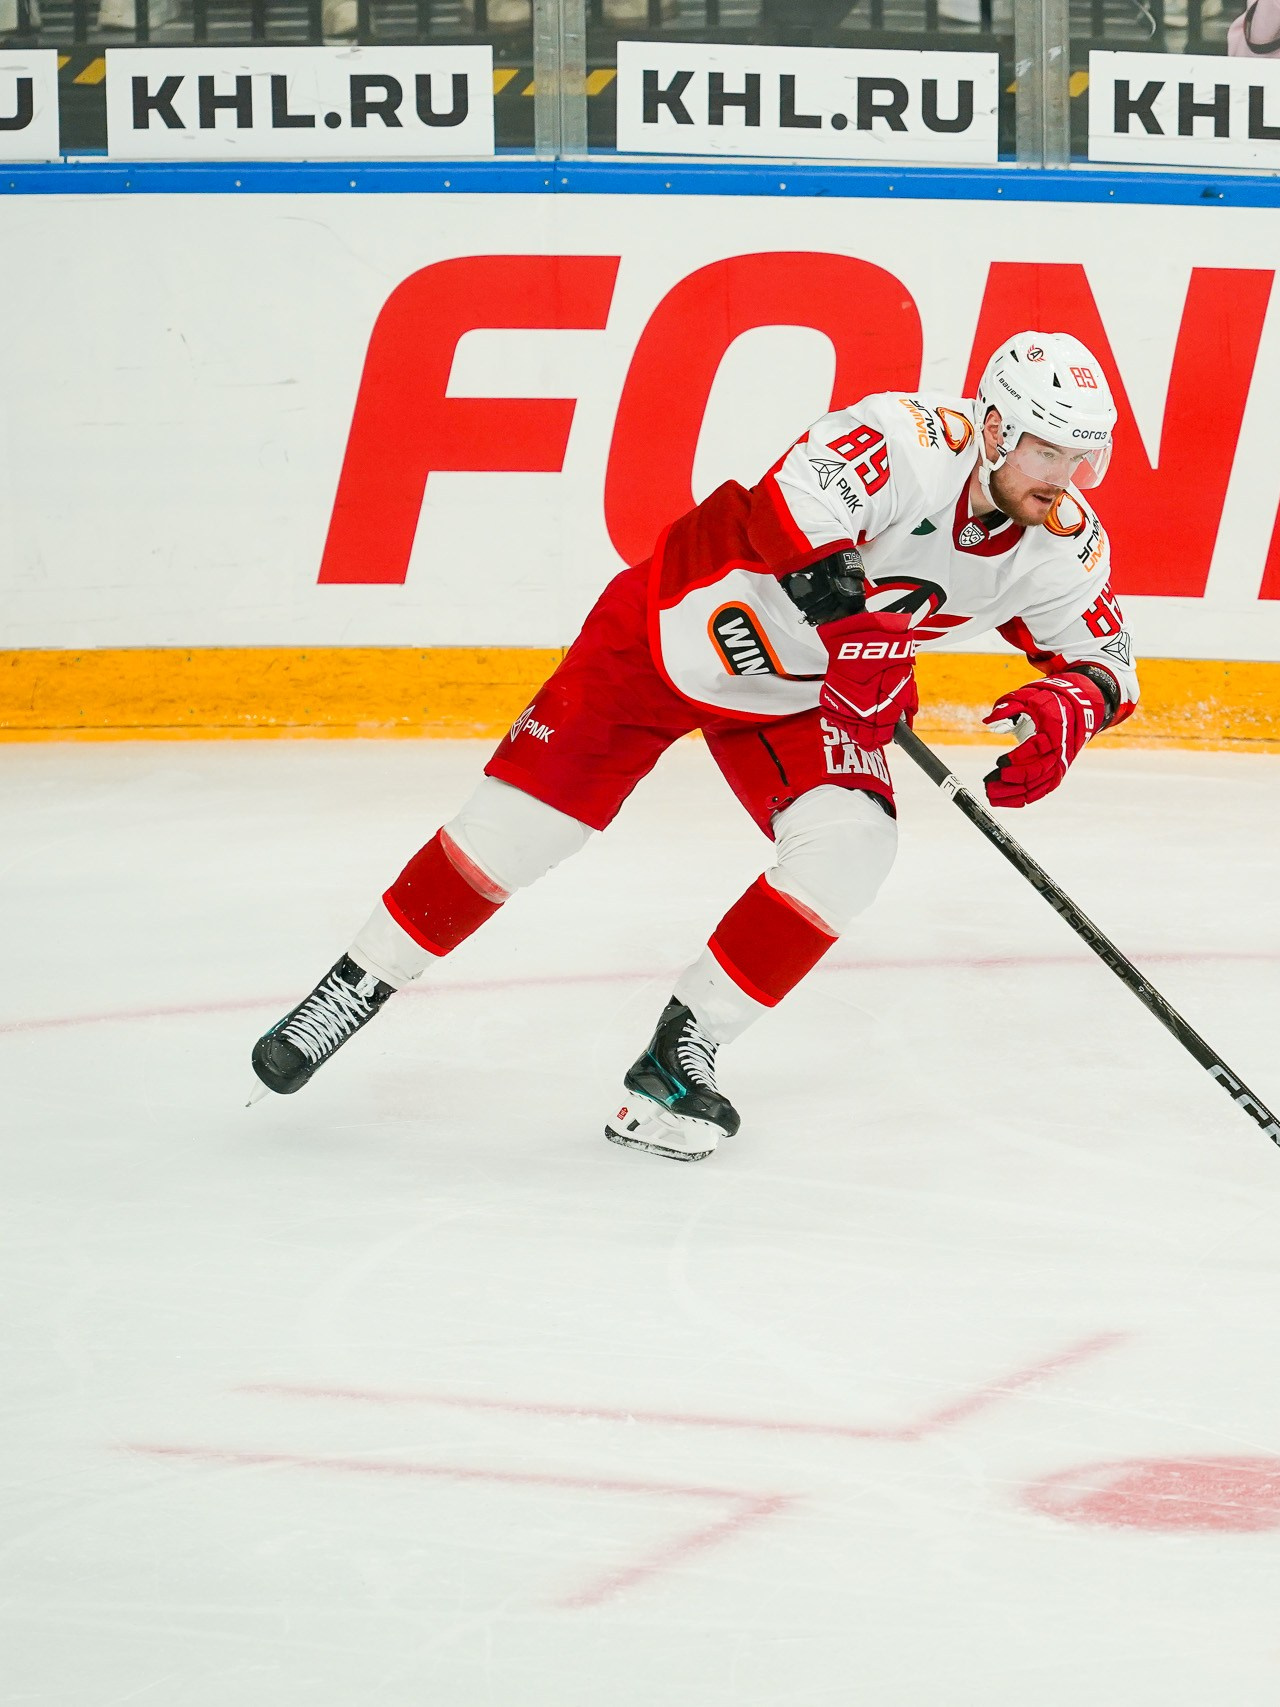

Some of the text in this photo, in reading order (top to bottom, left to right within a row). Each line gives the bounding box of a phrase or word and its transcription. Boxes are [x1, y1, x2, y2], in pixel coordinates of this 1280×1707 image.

[132, 74, 469, 130] KHL.RU
[643, 70, 974, 134] KHL.RU
[1069, 367, 1098, 389] 89
[825, 424, 891, 496] 89
[717, 616, 770, 675] WIN
